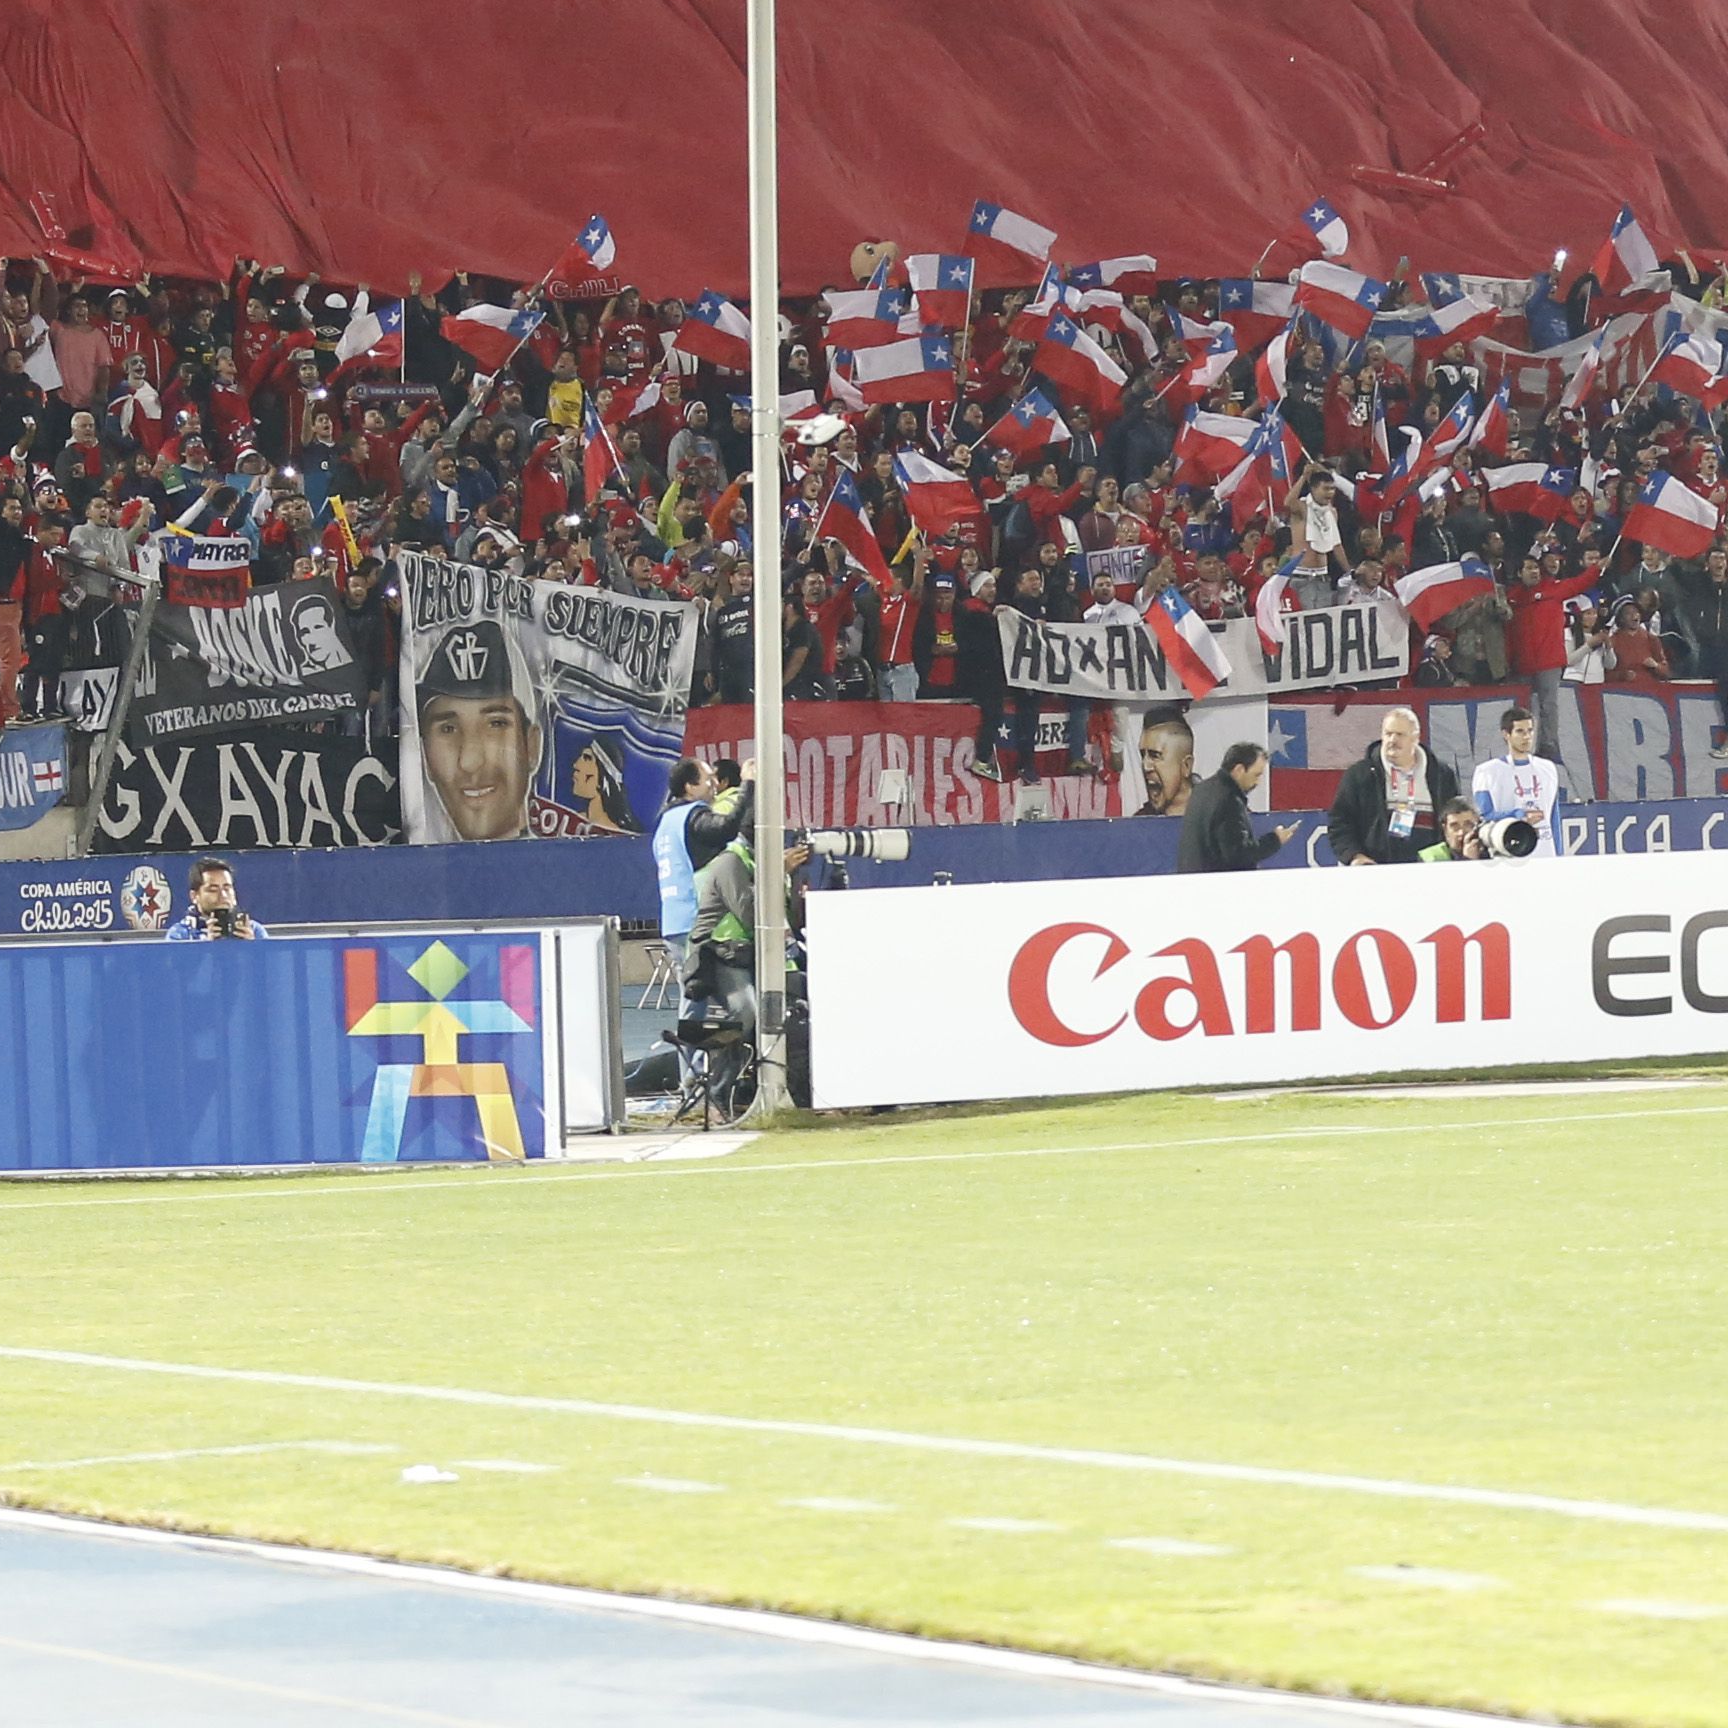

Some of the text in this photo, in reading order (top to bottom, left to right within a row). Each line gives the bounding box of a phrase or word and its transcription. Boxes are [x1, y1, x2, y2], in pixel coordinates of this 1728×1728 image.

[193, 542, 249, 562] MAYRA
[143, 701, 248, 737] VETERANOS
[246, 695, 282, 720] DEL
[20, 877, 113, 899] COPA AMÉRICA
[69, 899, 115, 930] 2015
[1006, 917, 1513, 1049] Canon
